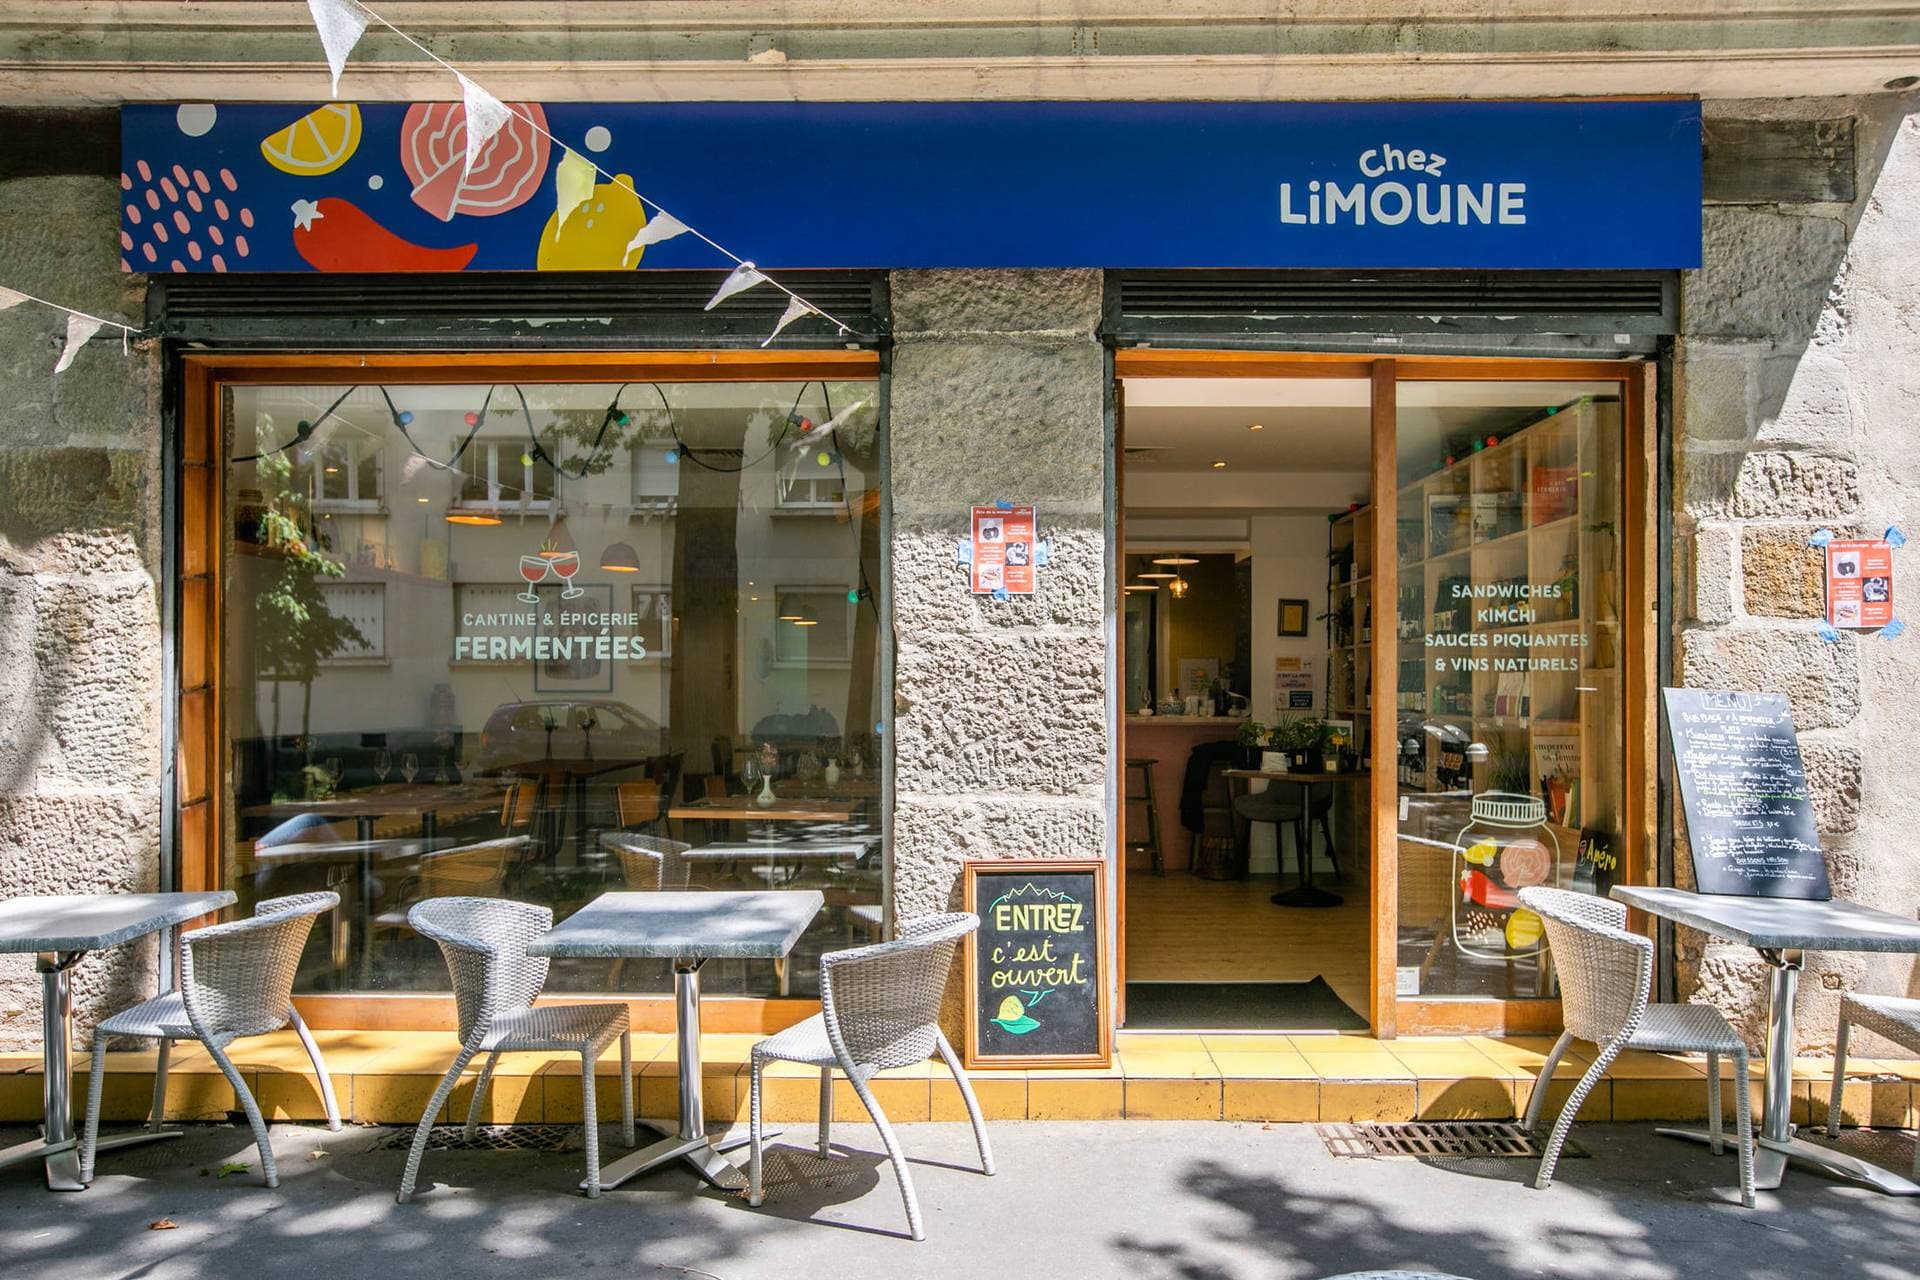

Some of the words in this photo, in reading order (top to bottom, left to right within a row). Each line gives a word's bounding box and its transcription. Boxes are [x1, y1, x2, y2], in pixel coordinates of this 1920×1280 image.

[1359, 144, 1447, 178] Chez
[1280, 181, 1527, 226] LiMOUNE
[1451, 584, 1562, 598] SANDWICHES
[463, 613, 537, 626] CANTINE
[543, 613, 554, 626] &
[560, 611, 639, 626] ÉPICERIE
[1478, 609, 1536, 623] KIMCHI
[455, 628, 647, 661] FERMENTÉES
[1425, 634, 1488, 647] SAUCES
[1493, 633, 1589, 647] PIQUANTES
[1434, 659, 1446, 672] &
[1451, 658, 1489, 671] VINS
[1494, 658, 1578, 671] NATURELS
[1705, 694, 1747, 709] MENU
[1586, 837, 1617, 875] Apéro
[995, 903, 1085, 933] ENTREZ
[991, 938, 1057, 964] c'est
[991, 952, 1088, 988] ouvert
